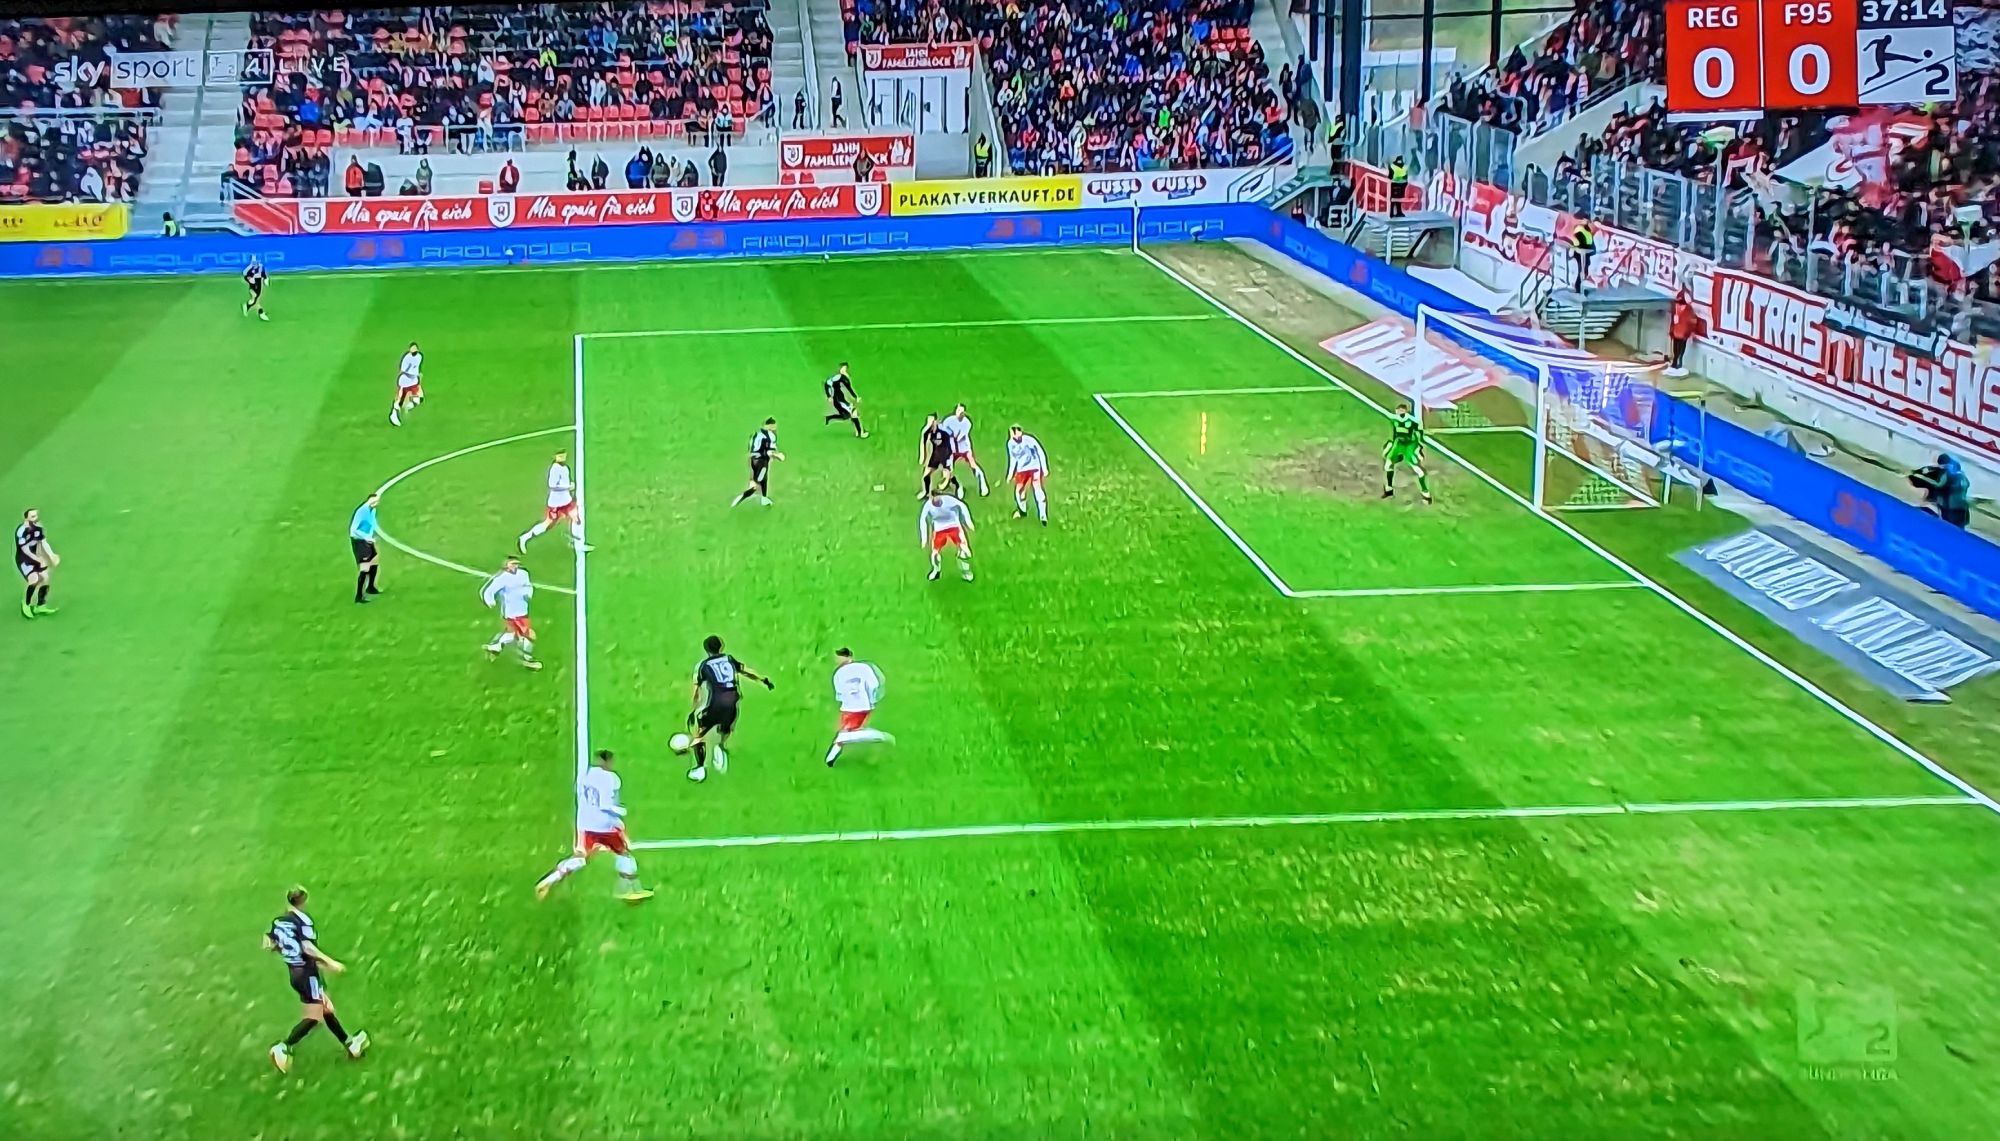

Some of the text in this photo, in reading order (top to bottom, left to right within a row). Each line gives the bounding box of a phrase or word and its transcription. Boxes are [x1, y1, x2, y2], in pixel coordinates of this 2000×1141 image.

[1688, 6, 1738, 28] REG
[1784, 3, 1832, 25] F95
[1862, 0, 1947, 22] 37:14
[54, 56, 105, 87] sky
[116, 57, 196, 84] sport
[279, 57, 346, 73] LIVE
[1693, 47, 1735, 98] 0
[1788, 43, 1831, 95] 0
[1925, 63, 1950, 95] 2
[899, 187, 1075, 208] PLAKAT-VERKAUFT.DE
[1720, 277, 1826, 366] ULTRAS
[711, 661, 733, 683] 19
[1866, 1022, 1890, 1055] 2
